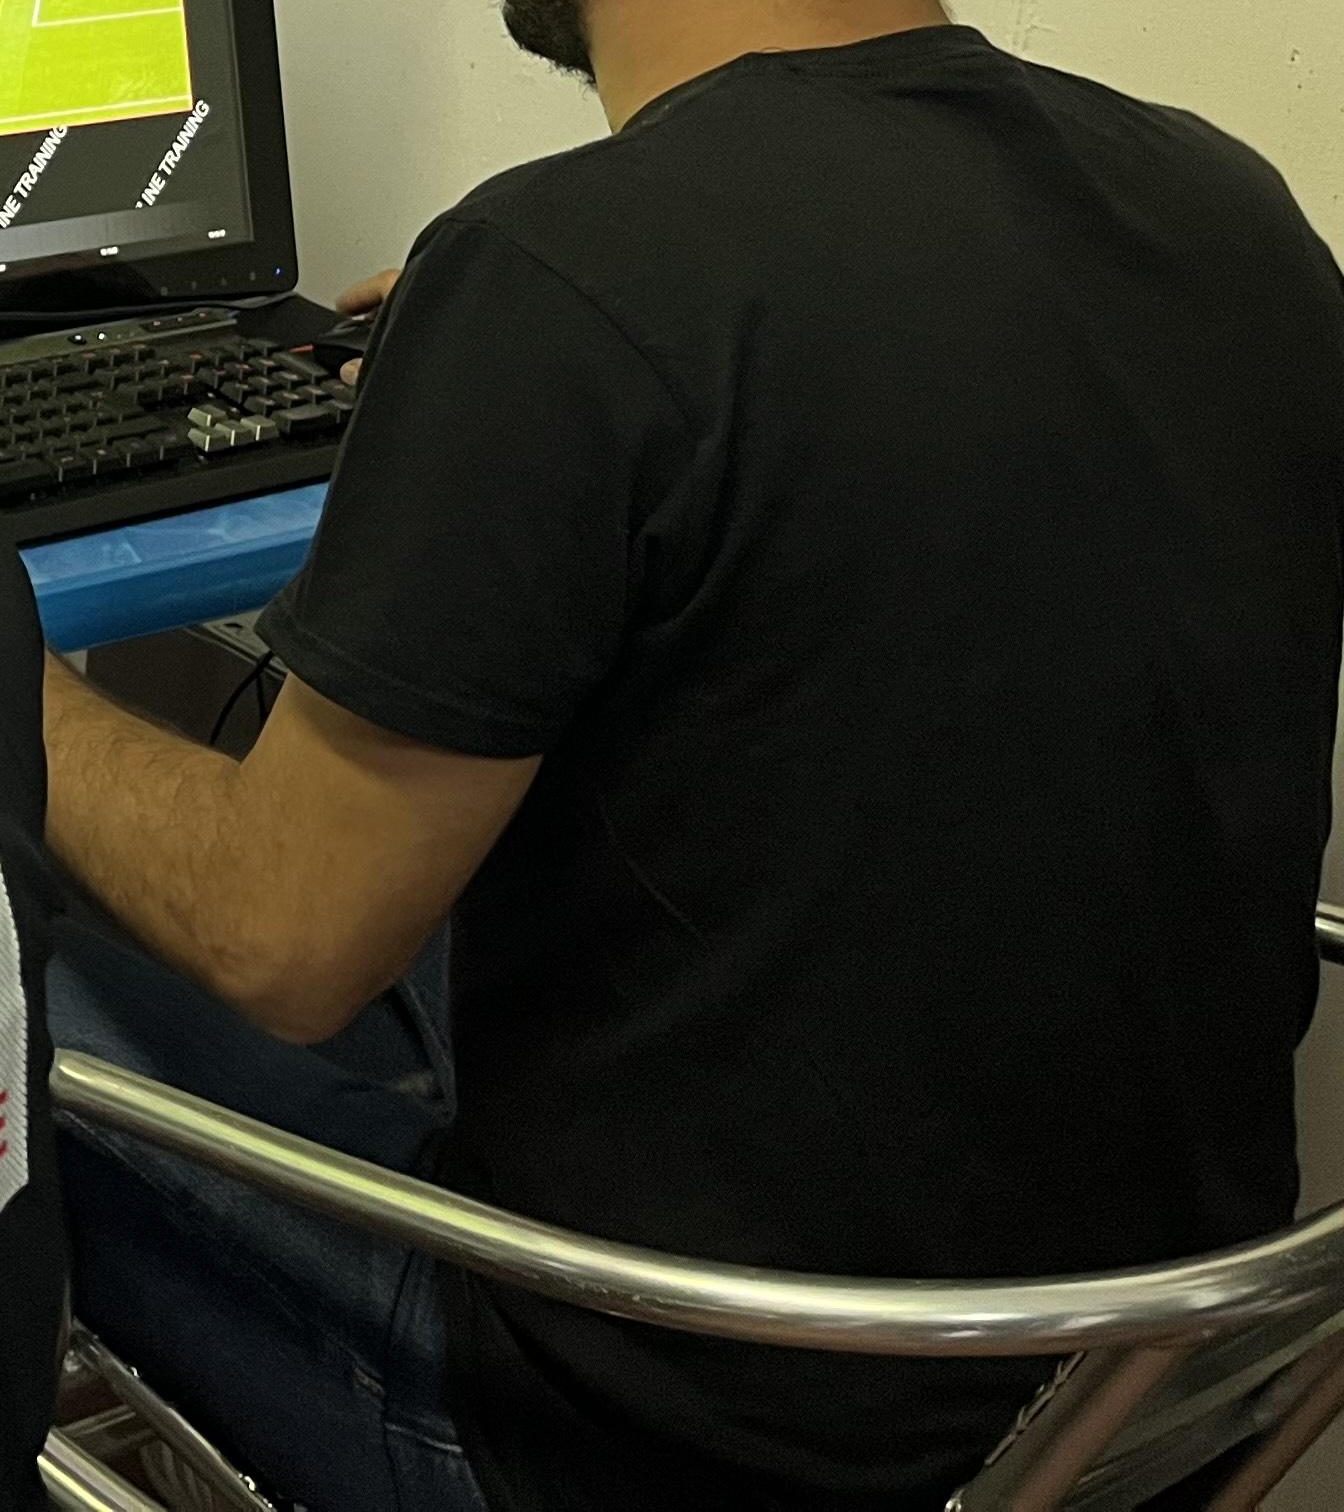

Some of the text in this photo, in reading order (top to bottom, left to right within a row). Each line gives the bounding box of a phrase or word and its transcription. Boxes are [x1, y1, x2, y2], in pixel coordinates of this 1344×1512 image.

[14, 124, 69, 198] TRAINING
[135, 98, 211, 208] INE TRAINING
